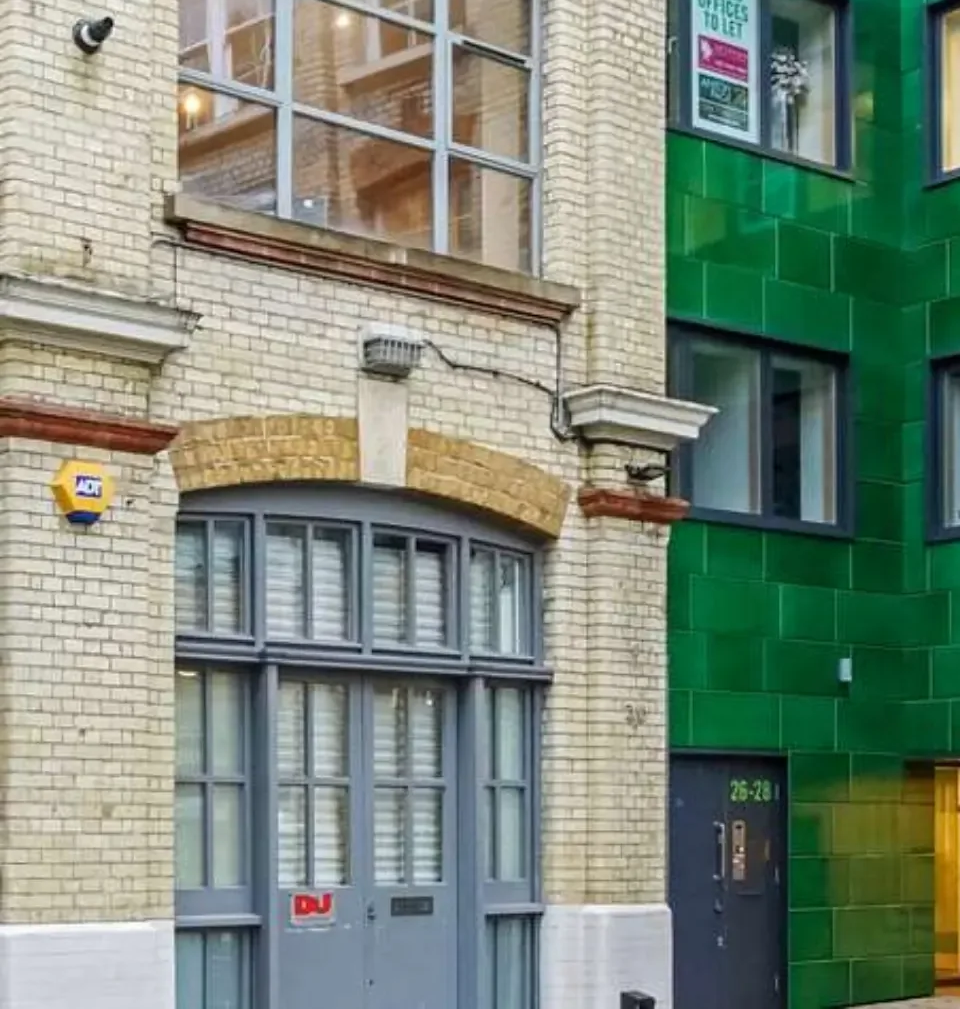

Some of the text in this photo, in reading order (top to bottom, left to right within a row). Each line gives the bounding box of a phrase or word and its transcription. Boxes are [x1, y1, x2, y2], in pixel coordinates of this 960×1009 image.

[703, 11, 743, 39] TO LET
[76, 477, 102, 496] ADT
[730, 779, 771, 801] 26-28
[294, 893, 332, 915] DJ
